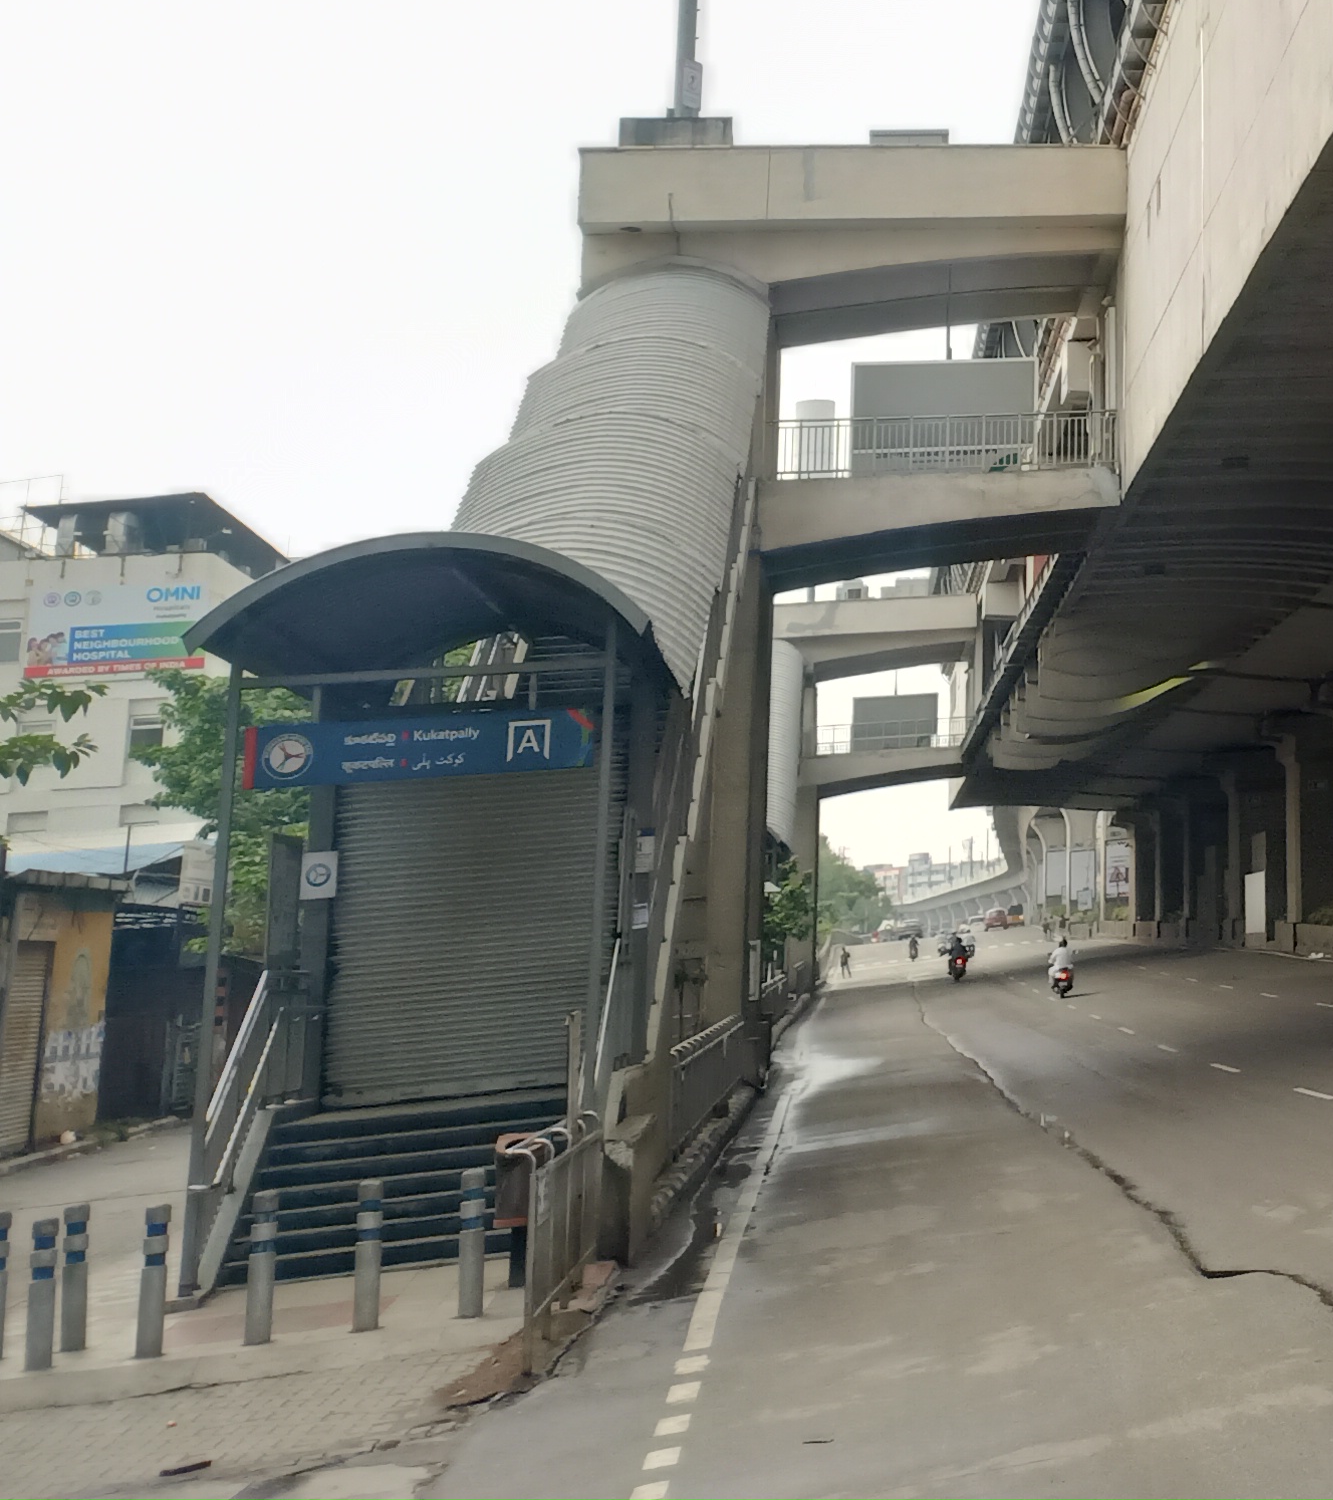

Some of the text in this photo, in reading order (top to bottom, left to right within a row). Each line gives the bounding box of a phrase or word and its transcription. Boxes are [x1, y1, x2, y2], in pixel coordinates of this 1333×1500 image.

[146, 585, 202, 603] OMNI
[74, 628, 105, 639] BEST
[73, 636, 180, 650] NEIGHBOURHOOD
[72, 650, 131, 661] HOSPITAL
[46, 666, 95, 676] AWARDED
[97, 664, 110, 673] BY
[113, 663, 142, 672] TIMES
[159, 660, 186, 669] INDIA
[413, 726, 480, 741] Kukatpally
